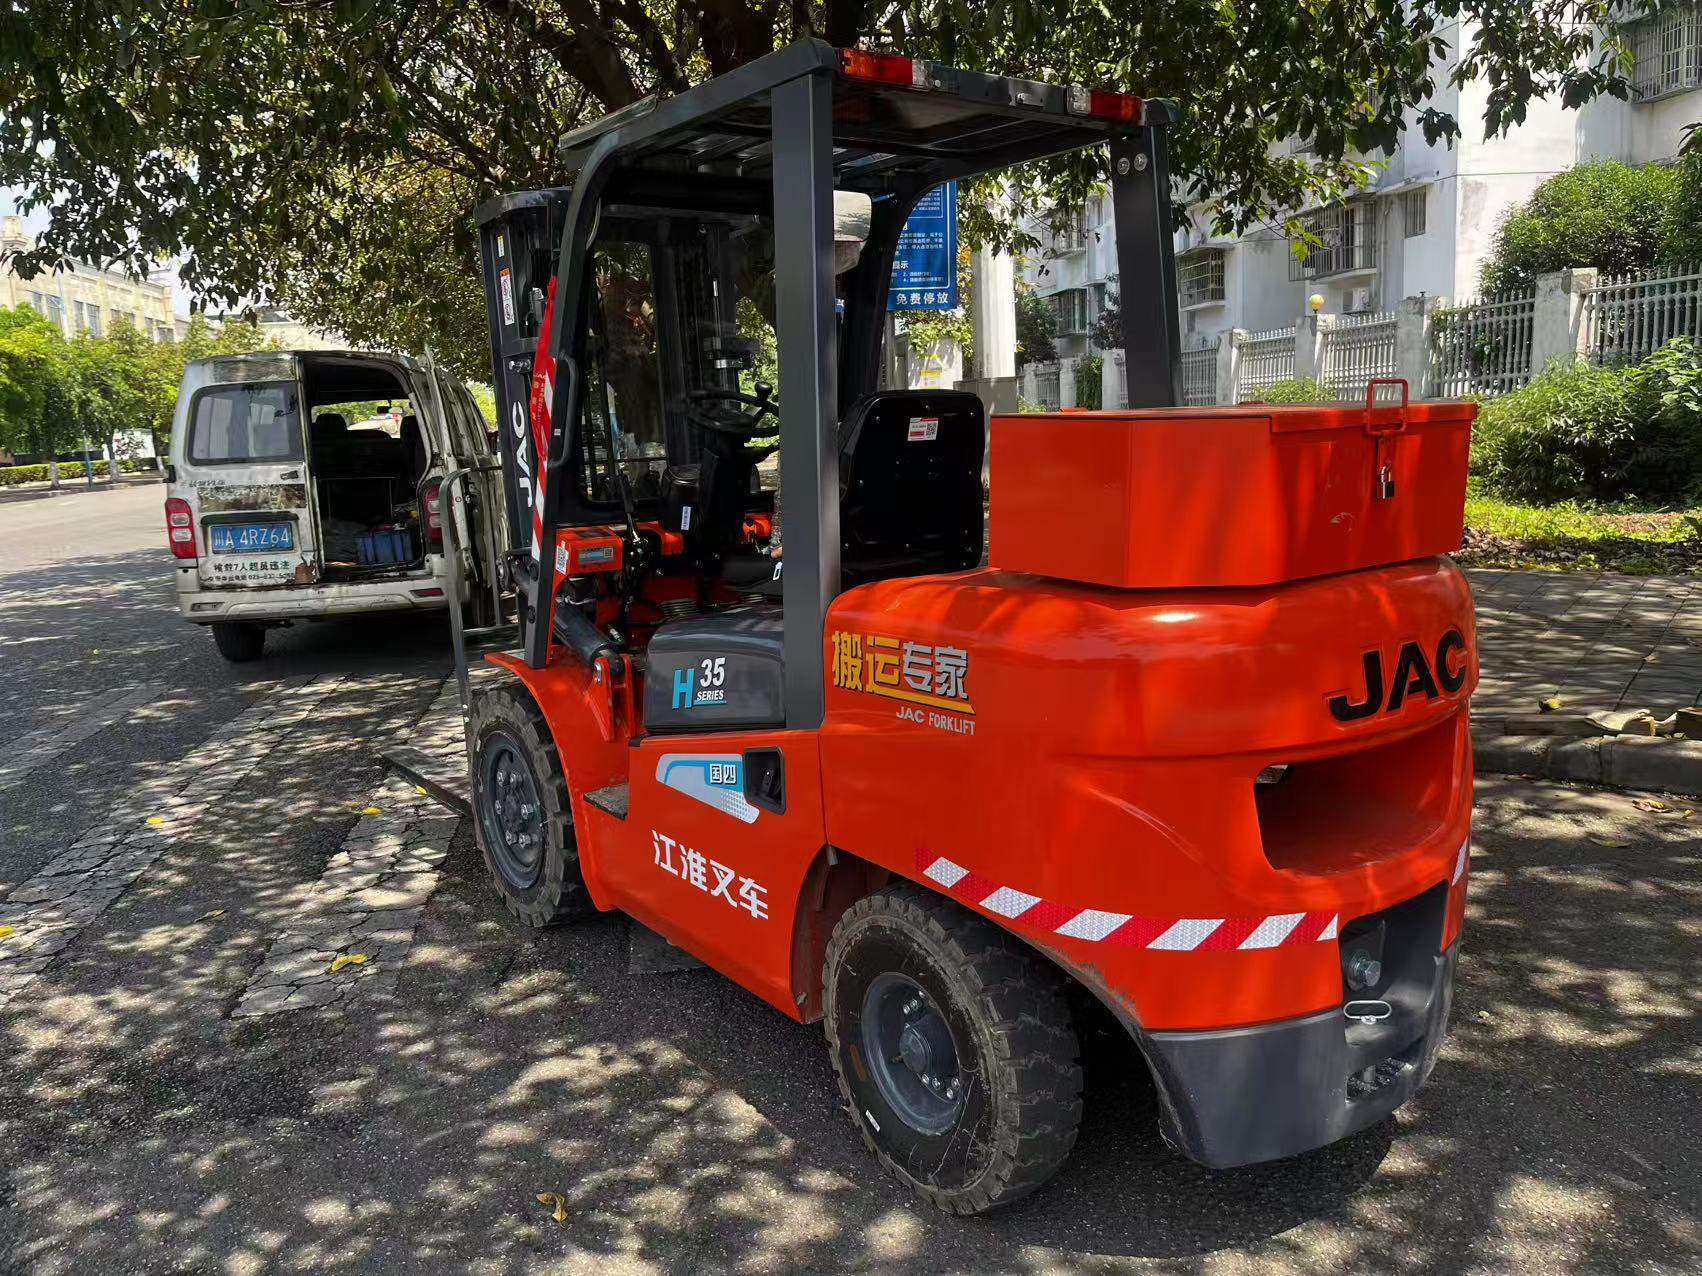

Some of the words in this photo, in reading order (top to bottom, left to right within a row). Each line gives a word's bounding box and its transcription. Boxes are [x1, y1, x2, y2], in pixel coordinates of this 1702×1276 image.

[896, 292, 949, 305] 免费停放
[512, 401, 533, 507] JAC
[672, 668, 695, 710] H
[699, 657, 726, 688] 35
[832, 630, 969, 699] 搬运专家
[1329, 629, 1467, 722] JAC
[696, 689, 724, 702] SERIES
[895, 706, 925, 724] JAC
[928, 712, 976, 736] FORKLIFT
[709, 763, 737, 784] 国四
[651, 829, 769, 920] 江淮叉车
